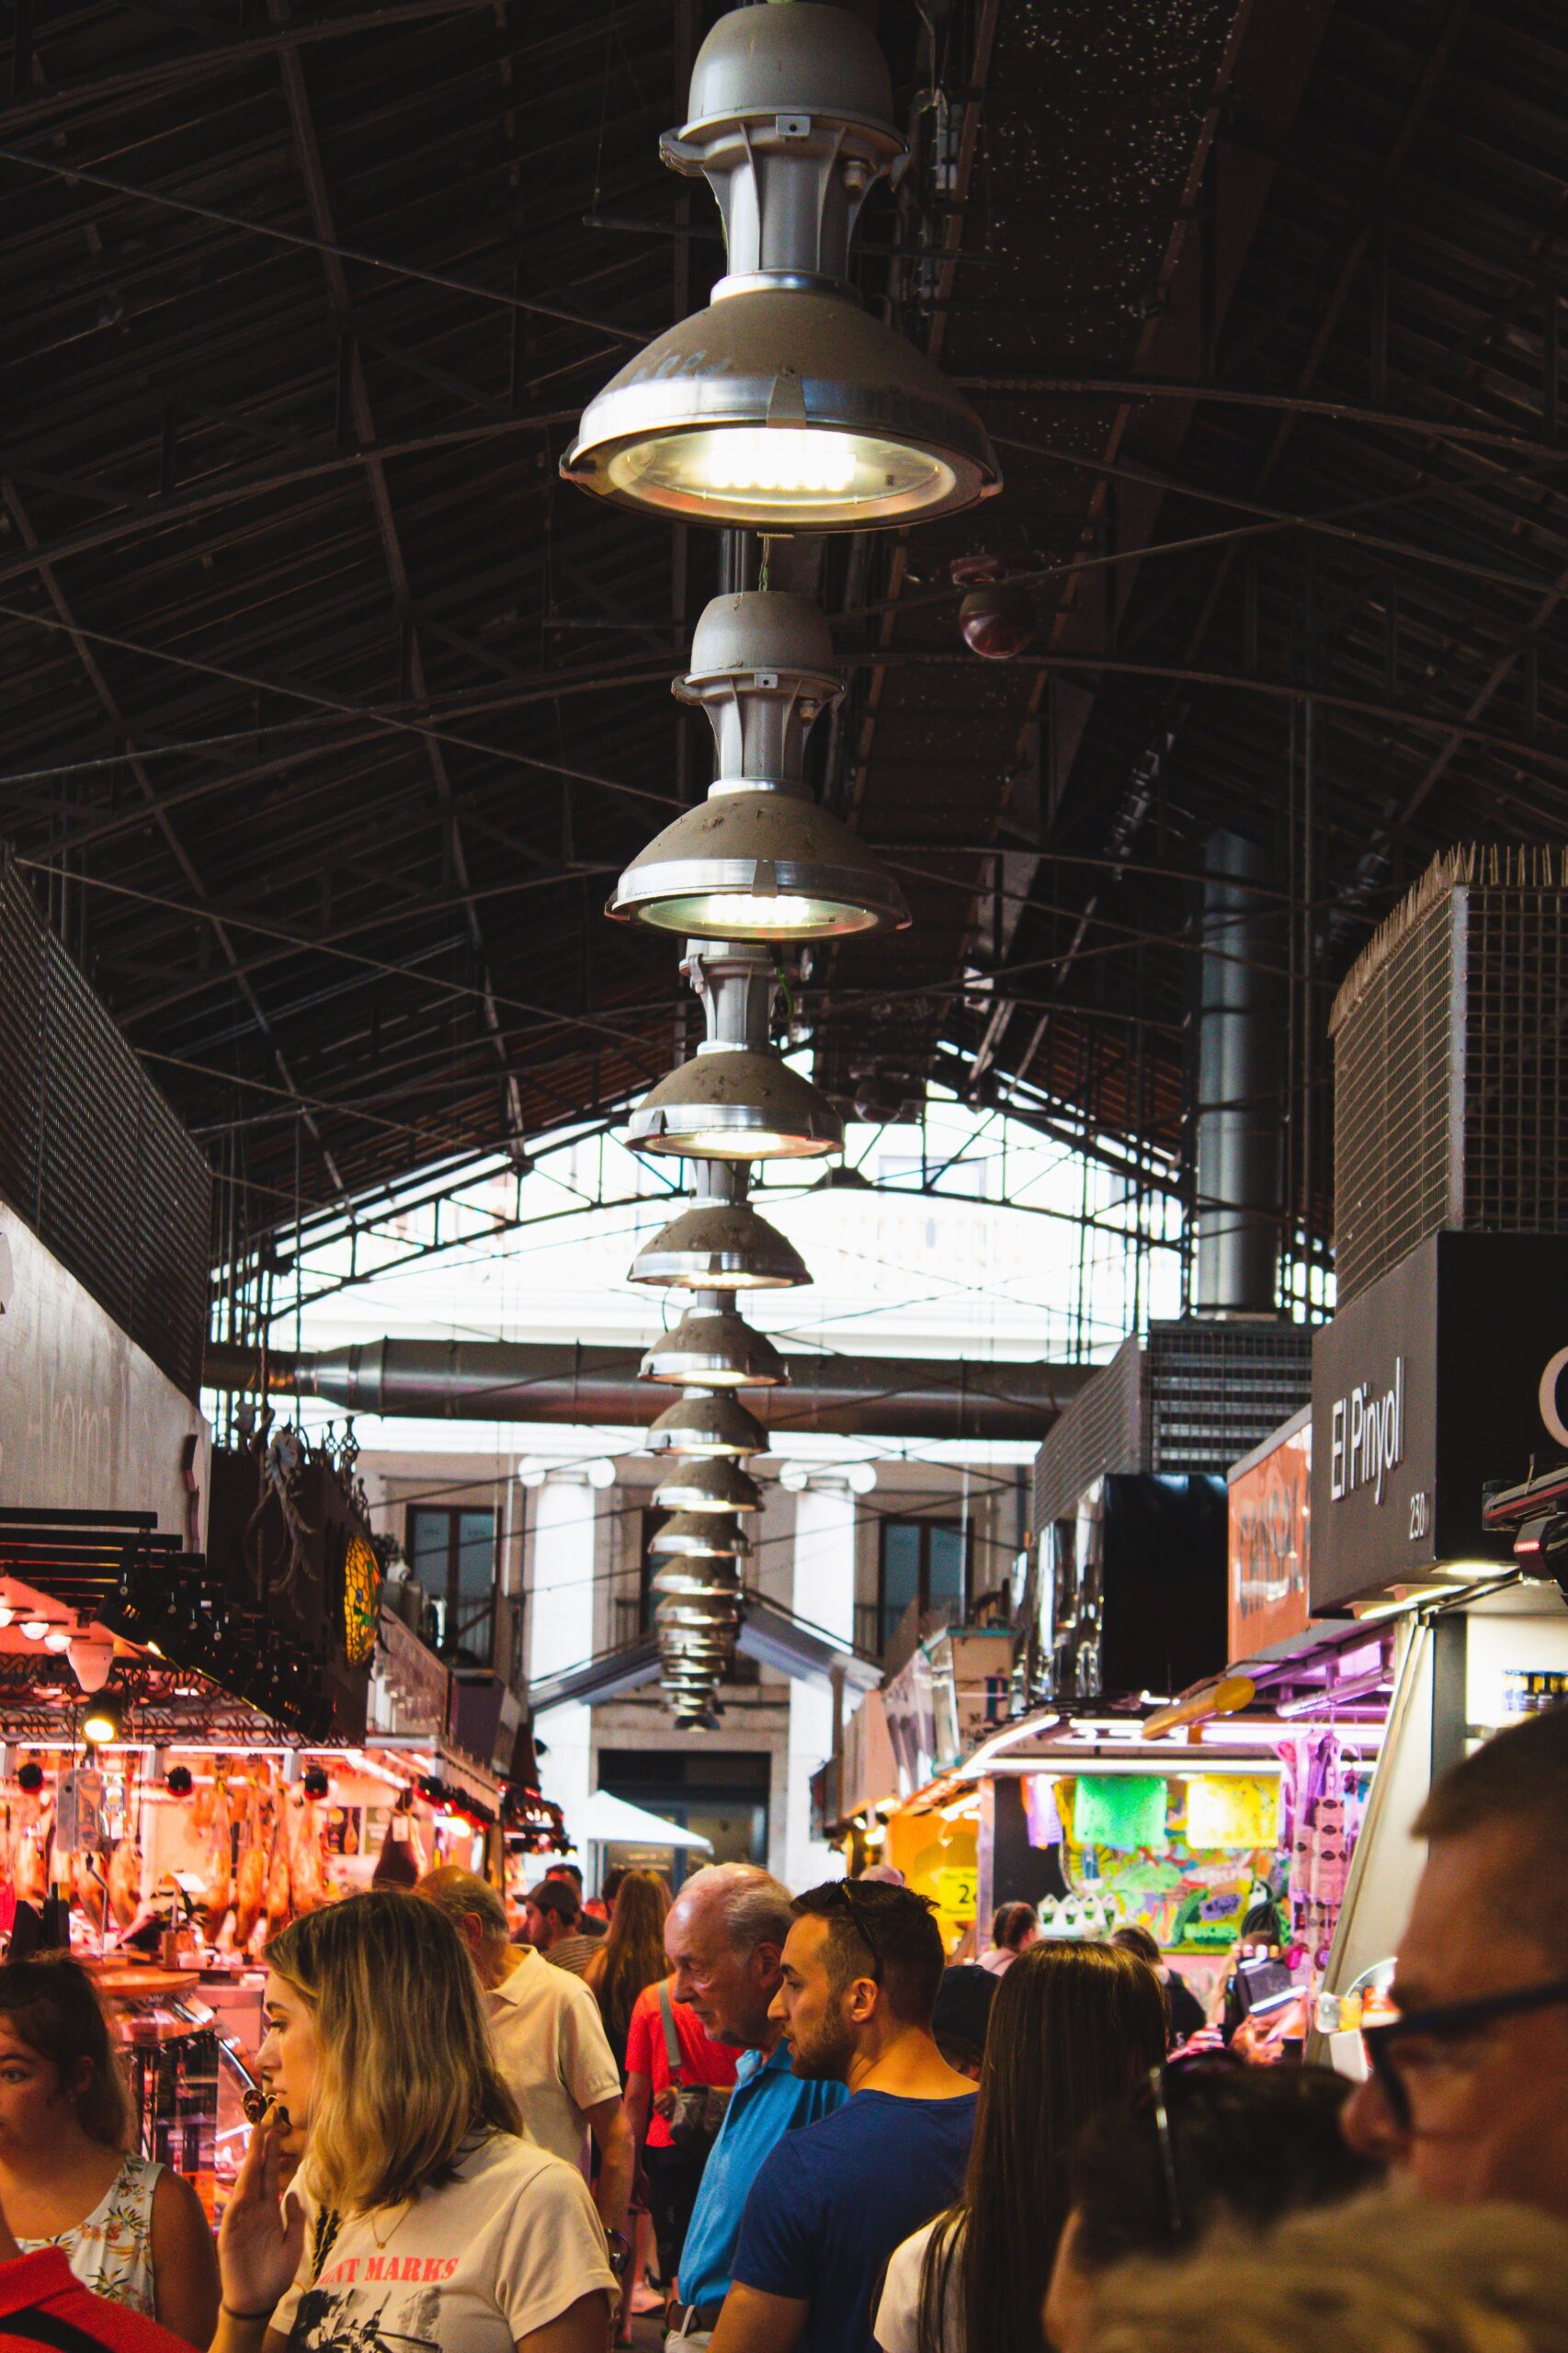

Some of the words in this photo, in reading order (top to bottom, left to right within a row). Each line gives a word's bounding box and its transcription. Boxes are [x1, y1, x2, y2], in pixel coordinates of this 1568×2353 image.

[1331, 1398, 1346, 1501] El
[1350, 1357, 1400, 1506] Pinyol
[364, 2256, 459, 2283] MARKS
